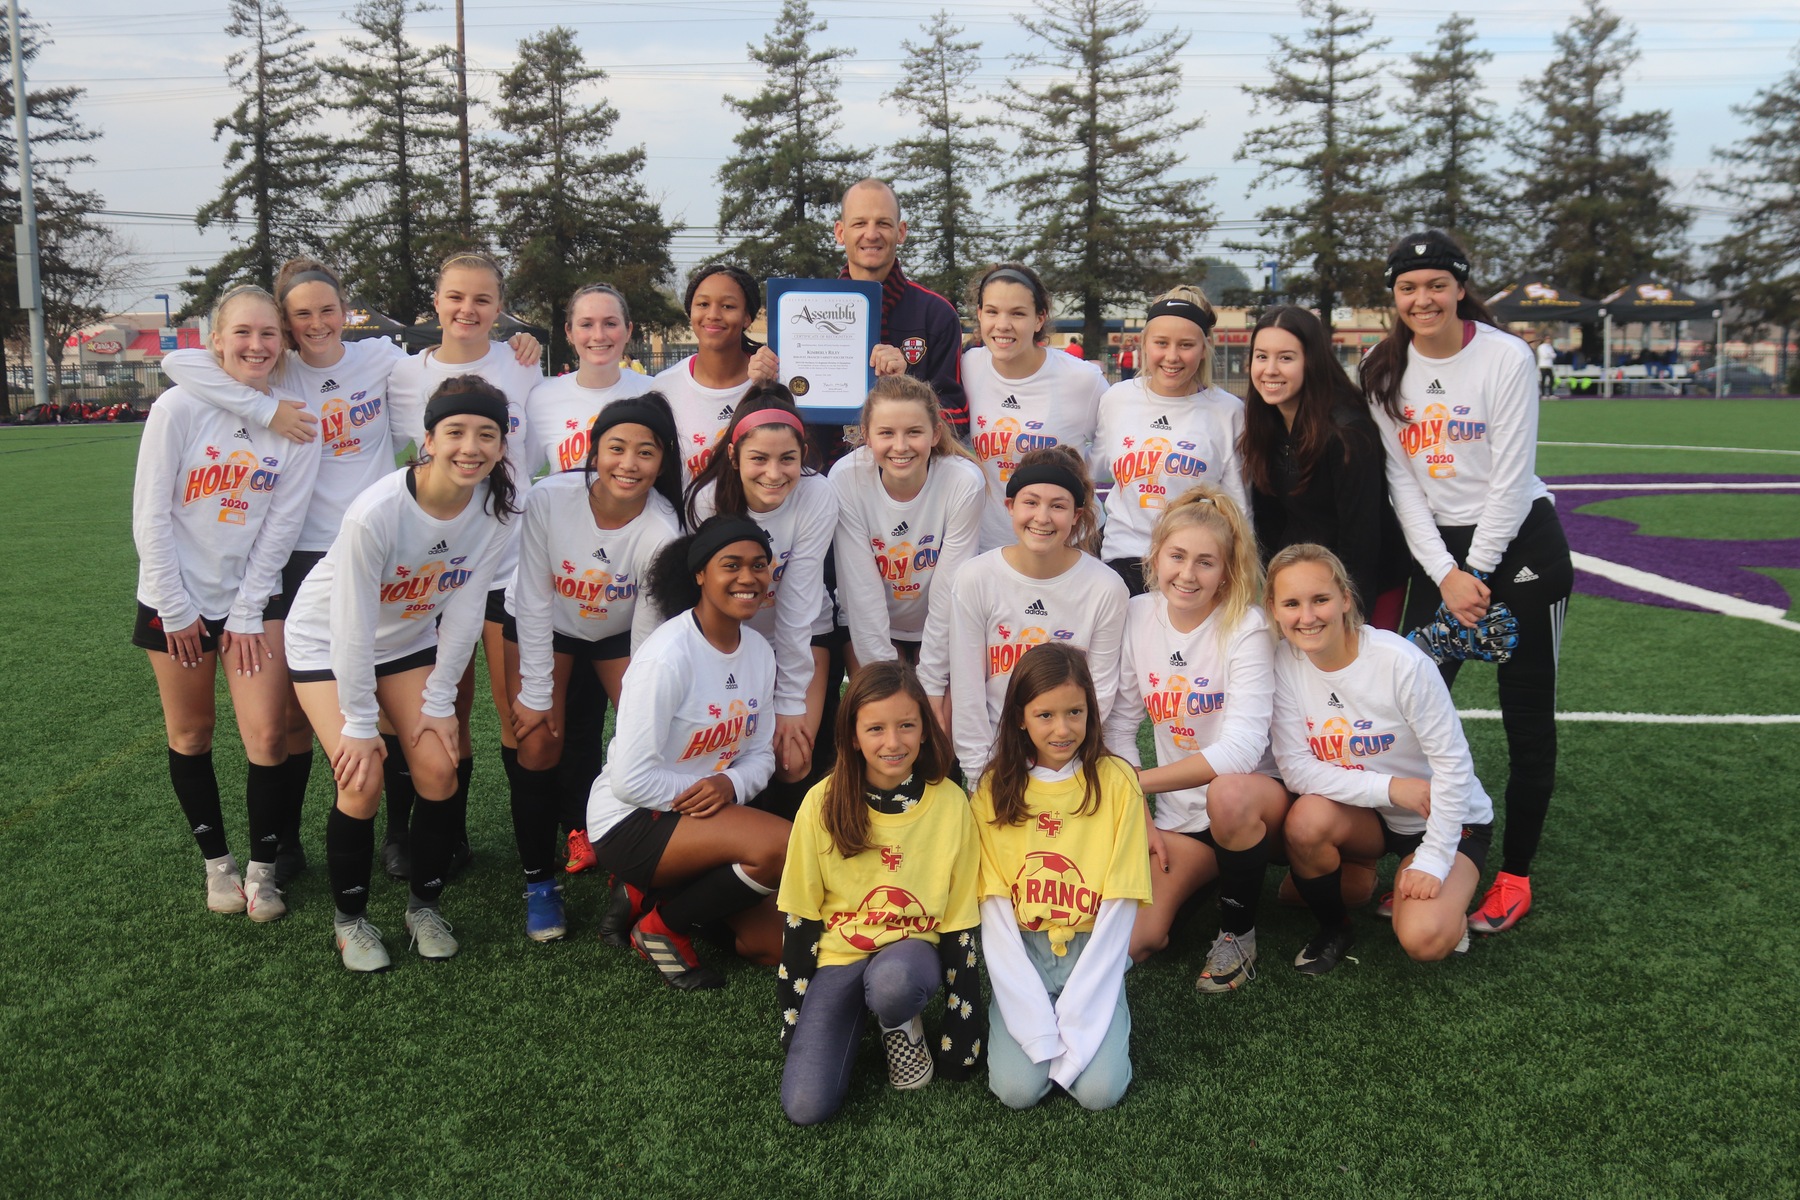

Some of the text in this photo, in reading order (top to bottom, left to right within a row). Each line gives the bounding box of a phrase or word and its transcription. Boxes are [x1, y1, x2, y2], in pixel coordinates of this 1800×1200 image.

[791, 303, 856, 325] Assembly
[320, 384, 340, 394] adidas
[1001, 402, 1021, 410] adidas
[1404, 406, 1416, 420] SF
[321, 397, 382, 443] LY CUP
[566, 419, 578, 430] SF
[977, 415, 987, 428] SF
[1025, 420, 1044, 430] CB
[1149, 423, 1172, 431] adidas
[332, 438, 360, 449] 2020
[693, 433, 706, 446] SF
[1122, 437, 1135, 449] SF
[1398, 419, 1487, 455] HOLY CUP
[558, 430, 592, 472] HO
[972, 431, 1058, 462] HOLY CUP
[1176, 440, 1197, 451] CB
[206, 446, 220, 460] SF
[1426, 455, 1454, 464] 2020
[687, 448, 712, 480] HO
[1113, 450, 1208, 490] HOLY CUP
[183, 464, 280, 506] HOLY CU
[1138, 484, 1166, 495] 2020
[220, 497, 249, 510] 2020
[872, 538, 886, 551] SF
[428, 547, 450, 556] adidas
[562, 560, 576, 574] SF
[875, 548, 940, 580] OLY CU
[396, 565, 411, 578] SF
[437, 568, 472, 593] CU
[1513, 573, 1540, 584] adidas
[892, 582, 920, 592] 2020
[405, 603, 436, 611] 2020
[579, 603, 609, 614] 2020
[1024, 608, 1048, 617] adidas
[998, 625, 1011, 640] SF
[1053, 629, 1075, 640] CB
[1149, 672, 1160, 688] SF
[1194, 676, 1210, 687] CB
[708, 704, 722, 719] SF
[1143, 691, 1225, 725] HOLY CUP
[1306, 716, 1314, 732] F
[1353, 719, 1373, 730] CB
[1169, 725, 1195, 737] 2020
[680, 716, 743, 761] HOLY
[1307, 733, 1396, 762] OLY CUP
[1037, 811, 1063, 838] SF
[880, 846, 904, 872] SF
[1026, 878, 1103, 916] RANCI
